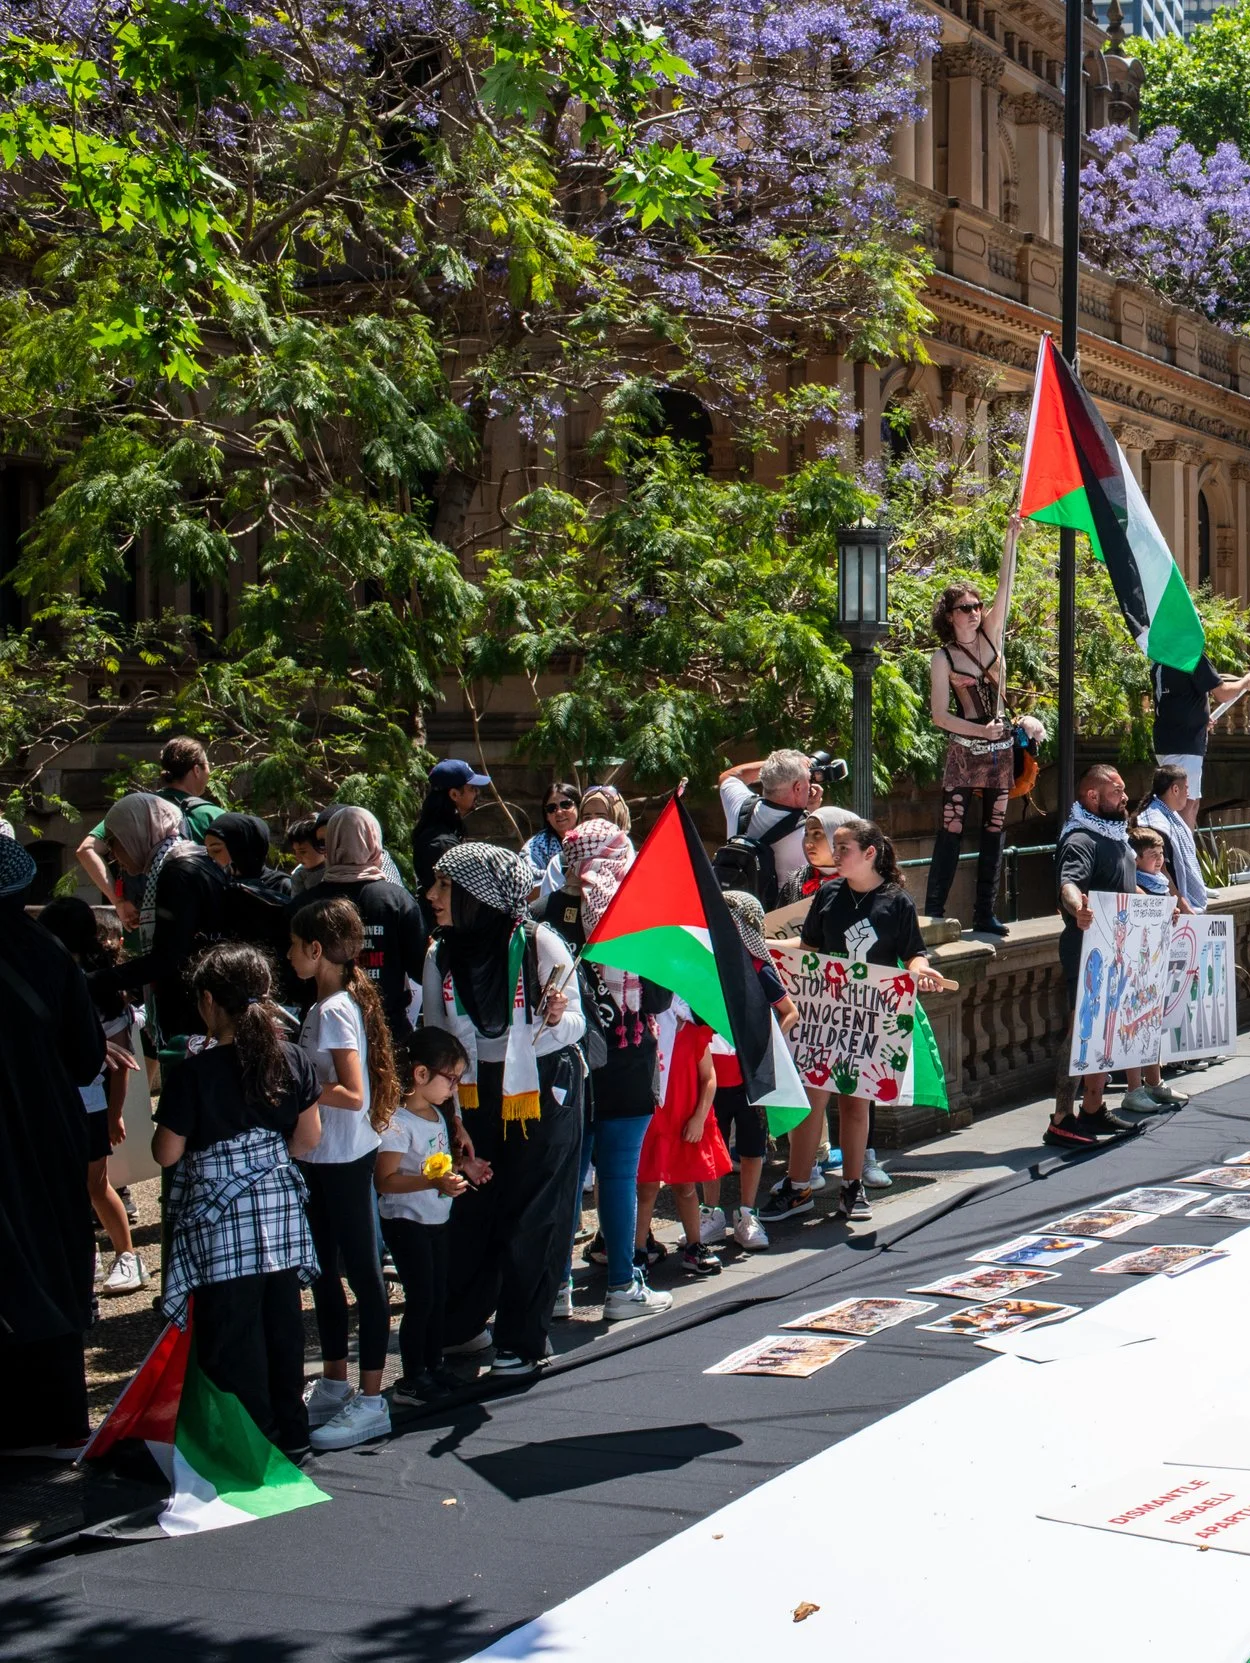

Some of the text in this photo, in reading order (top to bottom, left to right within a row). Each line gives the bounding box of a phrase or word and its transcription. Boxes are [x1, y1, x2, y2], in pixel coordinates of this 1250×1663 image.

[787, 971, 831, 998] STOP
[793, 1000, 879, 1034] NNOCENT
[789, 1023, 879, 1059] CHILDREN
[1108, 1479, 1210, 1525] DISMANTLE
[1164, 1492, 1236, 1525] ISRAELI
